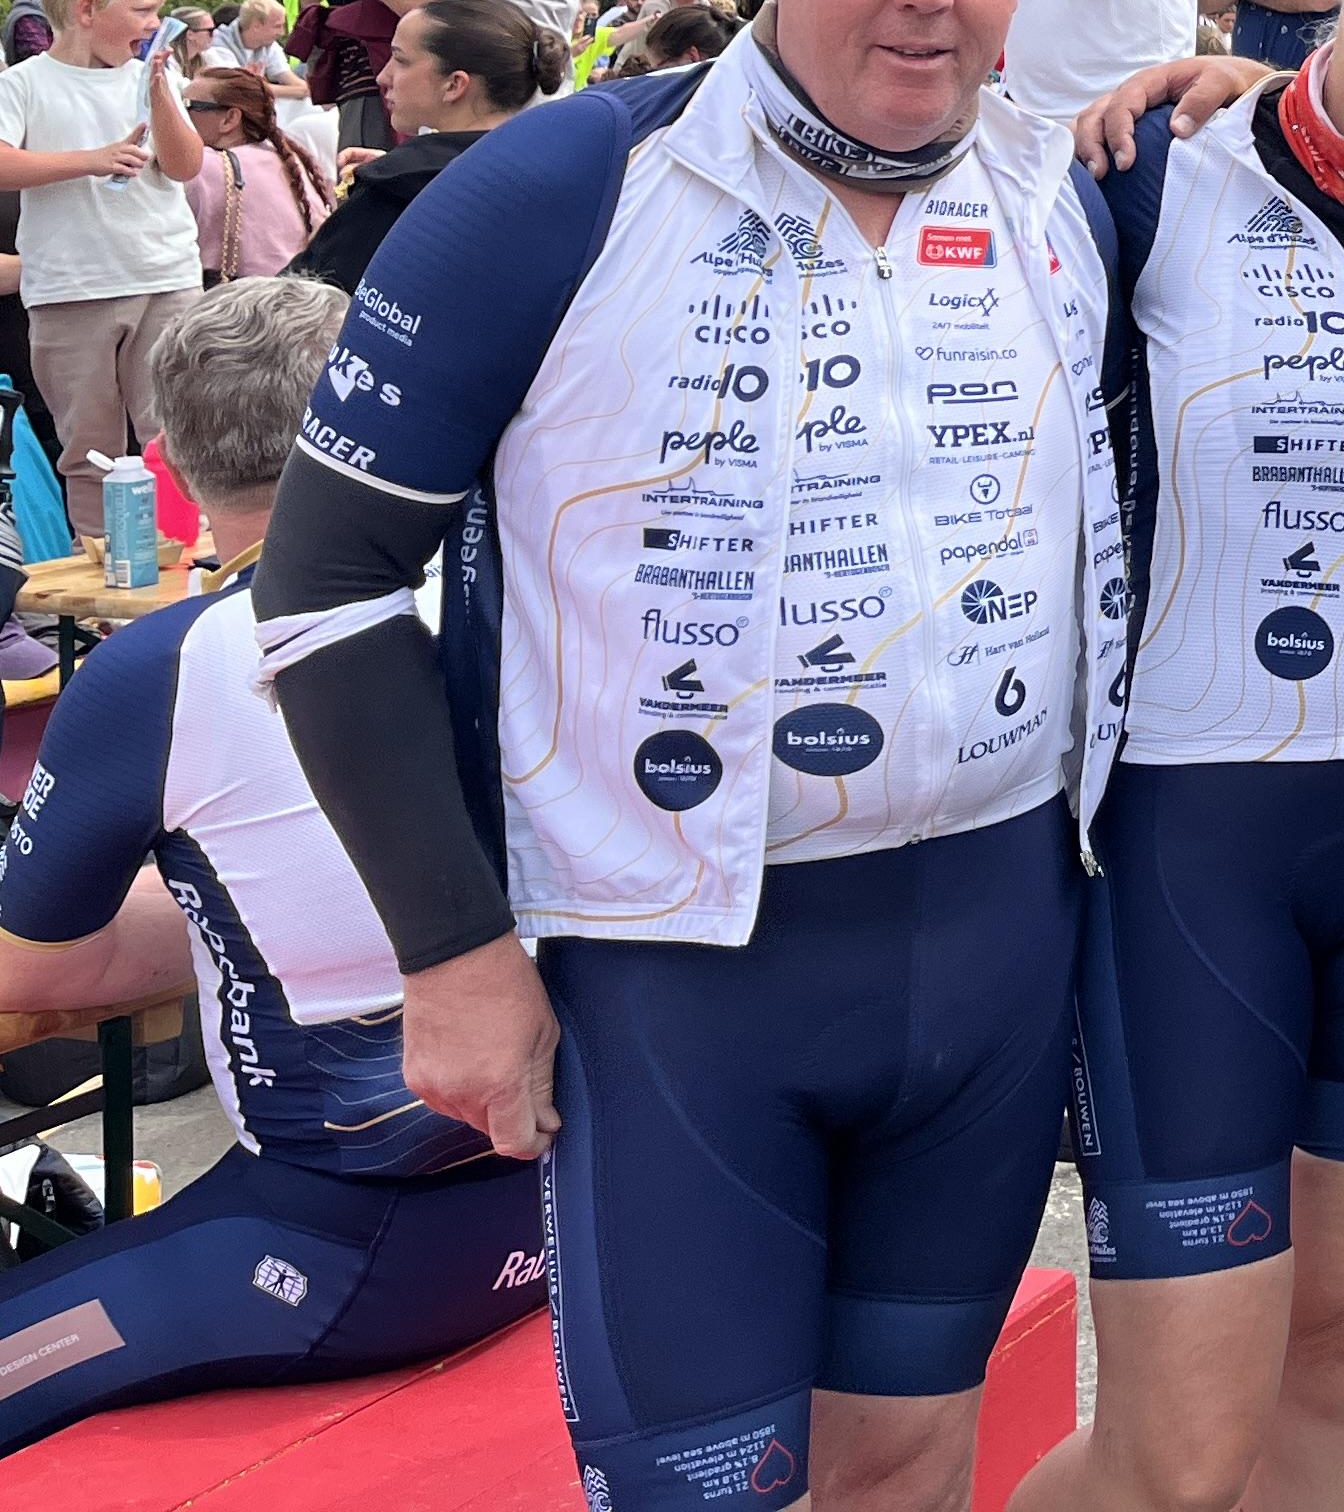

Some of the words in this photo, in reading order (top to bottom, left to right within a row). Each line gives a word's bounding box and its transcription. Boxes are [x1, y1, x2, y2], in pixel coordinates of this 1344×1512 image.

[925, 201, 988, 218] BIORACER
[1258, 286, 1334, 298] CISCO
[359, 310, 385, 332] product
[387, 326, 412, 347] media
[935, 346, 1017, 362] funraisin.co
[927, 422, 1034, 449] YPEX.nl
[642, 494, 763, 509] INTERTRAINING
[935, 512, 982, 526] BIKE
[668, 530, 753, 553] SHIFTER
[940, 531, 1022, 565] papendal
[635, 564, 754, 591] BRABANTHALLEN
[641, 609, 739, 647] flusso
[1267, 633, 1325, 650] bolsius
[995, 666, 1026, 717] 6
[787, 727, 870, 747] bolsius
[957, 709, 1048, 763] LOUWMAN
[645, 758, 711, 776] bolsius
[1074, 1067, 1094, 1147] BOUWEN
[0, 1353, 37, 1376] DESIGN
[38, 1334, 79, 1356] CENTER
[740, 1433, 750, 1441] m
[752, 1424, 776, 1438] 1850
[683, 1448, 702, 1458] sea
[706, 1438, 738, 1452] above
[739, 1440, 765, 1455] 1124
[656, 1453, 681, 1466] level
[726, 1450, 737, 1458] m
[674, 1454, 724, 1472] elevation
[686, 1462, 732, 1481] gradient
[702, 1478, 719, 1489] km
[736, 1481, 749, 1491] 21
[703, 1486, 733, 1500] turns
